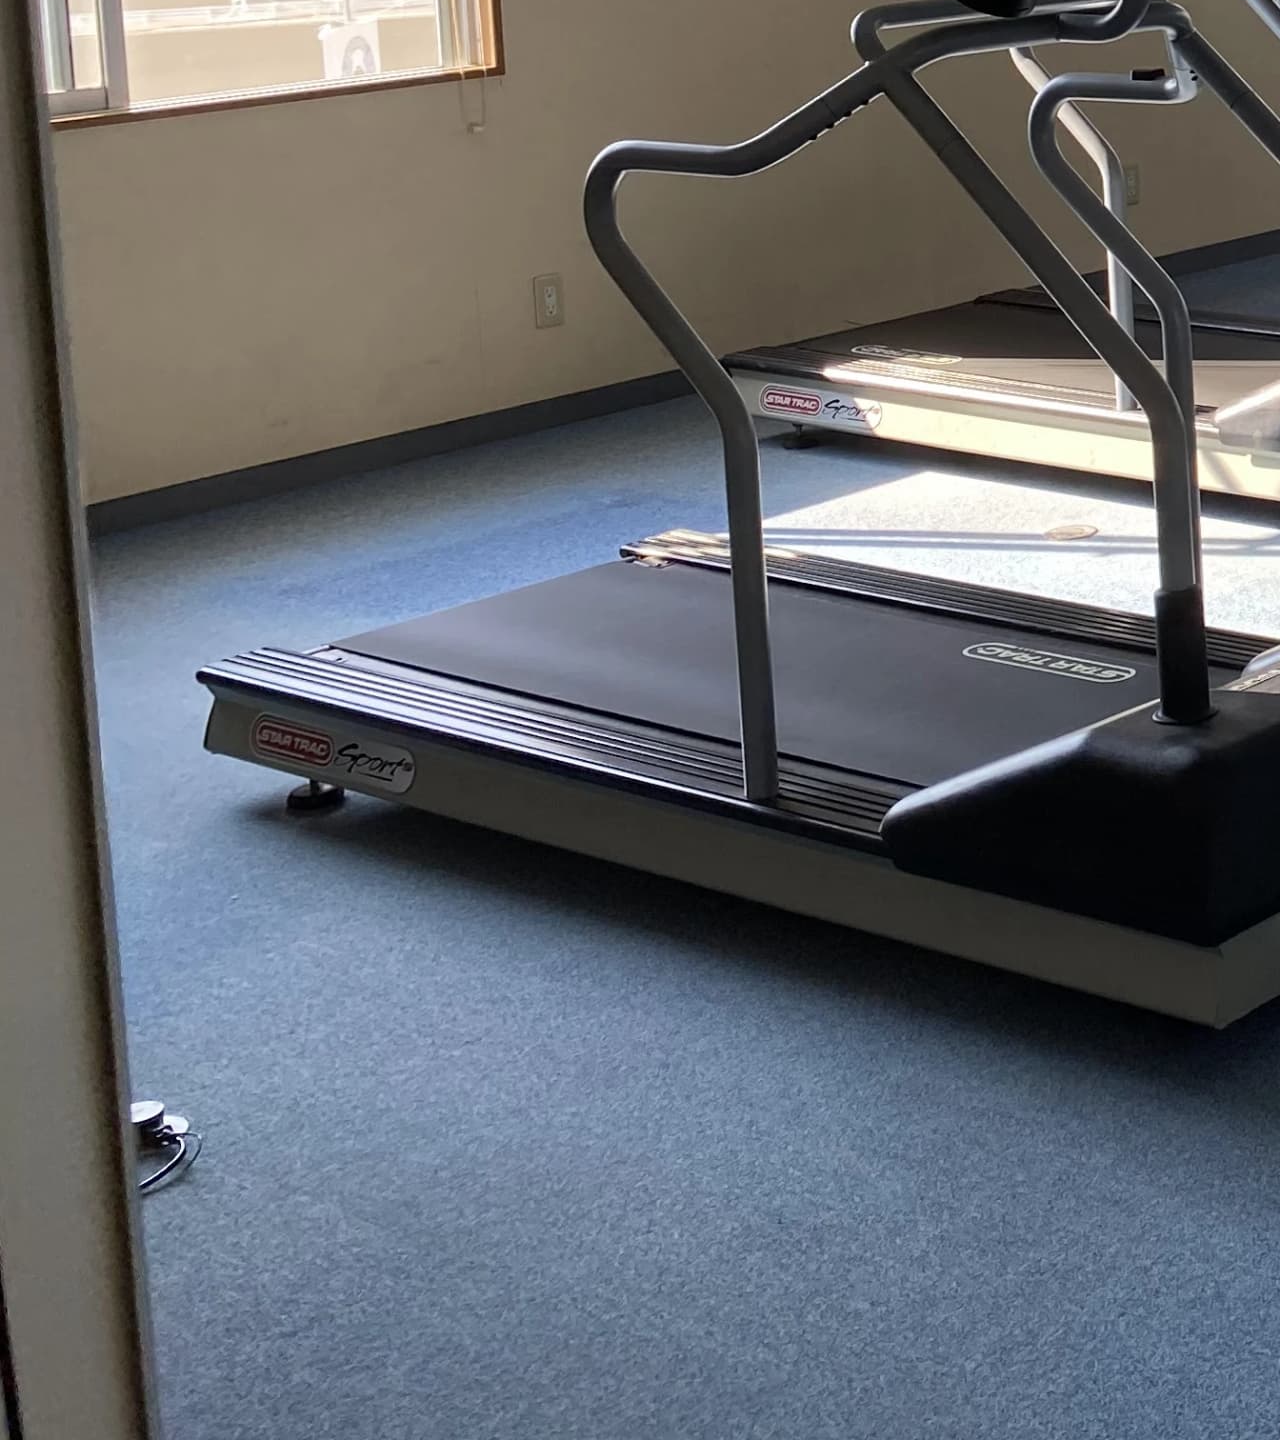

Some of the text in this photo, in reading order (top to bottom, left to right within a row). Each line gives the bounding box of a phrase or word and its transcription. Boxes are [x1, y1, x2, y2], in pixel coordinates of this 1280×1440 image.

[766, 394, 792, 406] STAR
[791, 398, 818, 410] TRAC
[976, 646, 1130, 678] STAR TRAC
[259, 728, 406, 776] STAR TRAC Sport
